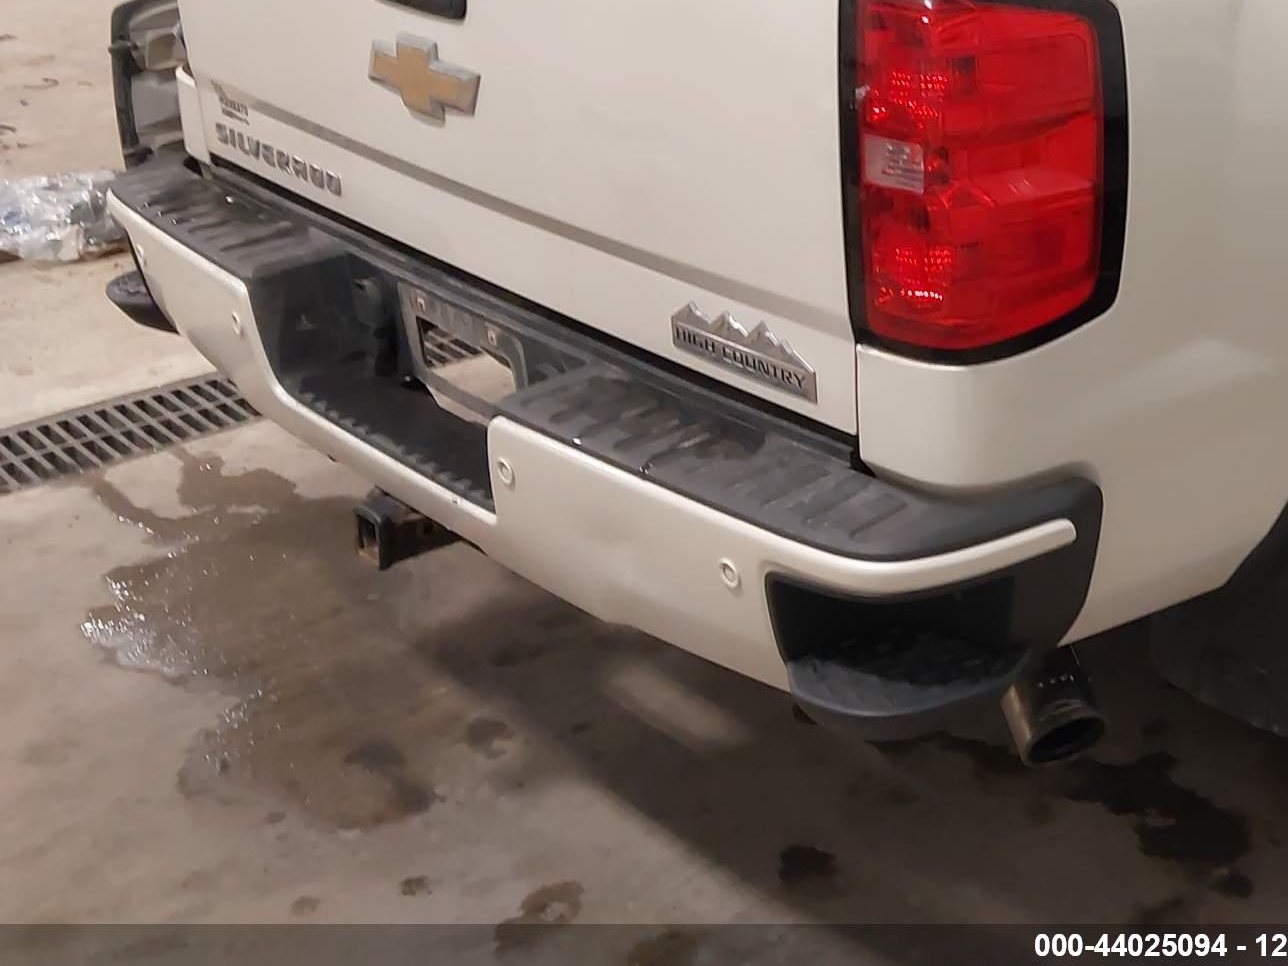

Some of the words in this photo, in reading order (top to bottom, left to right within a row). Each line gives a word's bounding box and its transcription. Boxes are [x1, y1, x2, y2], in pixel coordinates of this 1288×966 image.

[215, 121, 342, 197] SILVERADO
[675, 326, 716, 354] HIGH
[722, 345, 807, 389] COUNTRY
